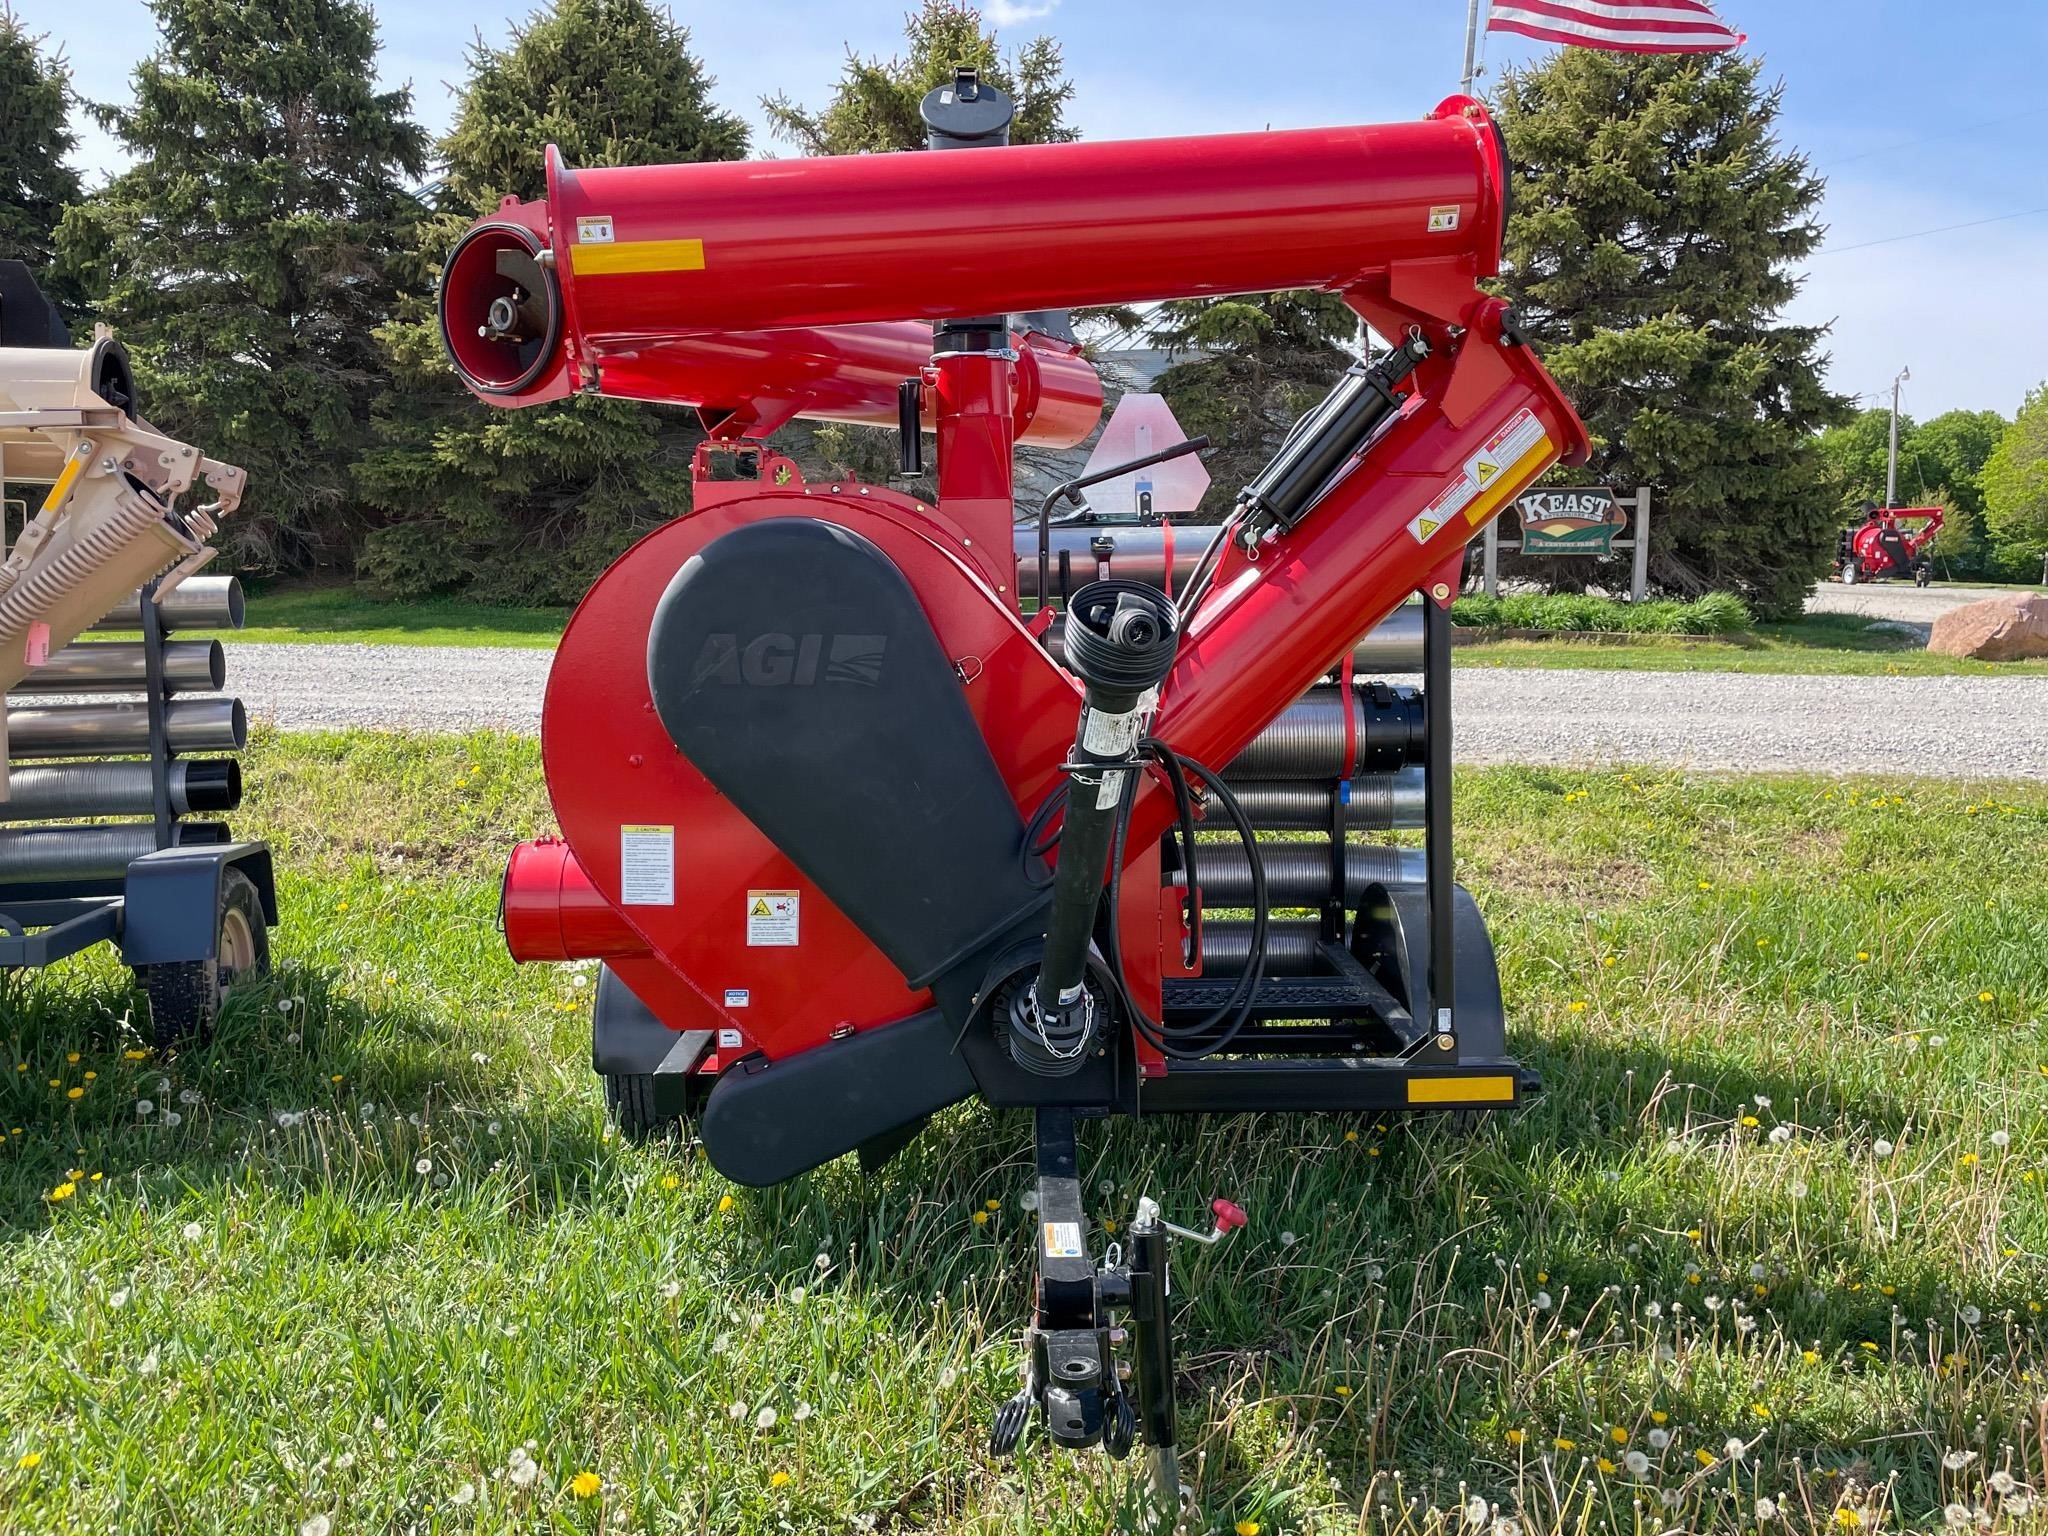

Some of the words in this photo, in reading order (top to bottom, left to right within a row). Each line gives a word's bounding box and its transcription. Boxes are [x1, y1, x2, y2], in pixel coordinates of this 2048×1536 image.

[1500, 414, 1525, 438] DANGER
[1518, 492, 1612, 523] KEAST
[690, 633, 823, 686] AGI
